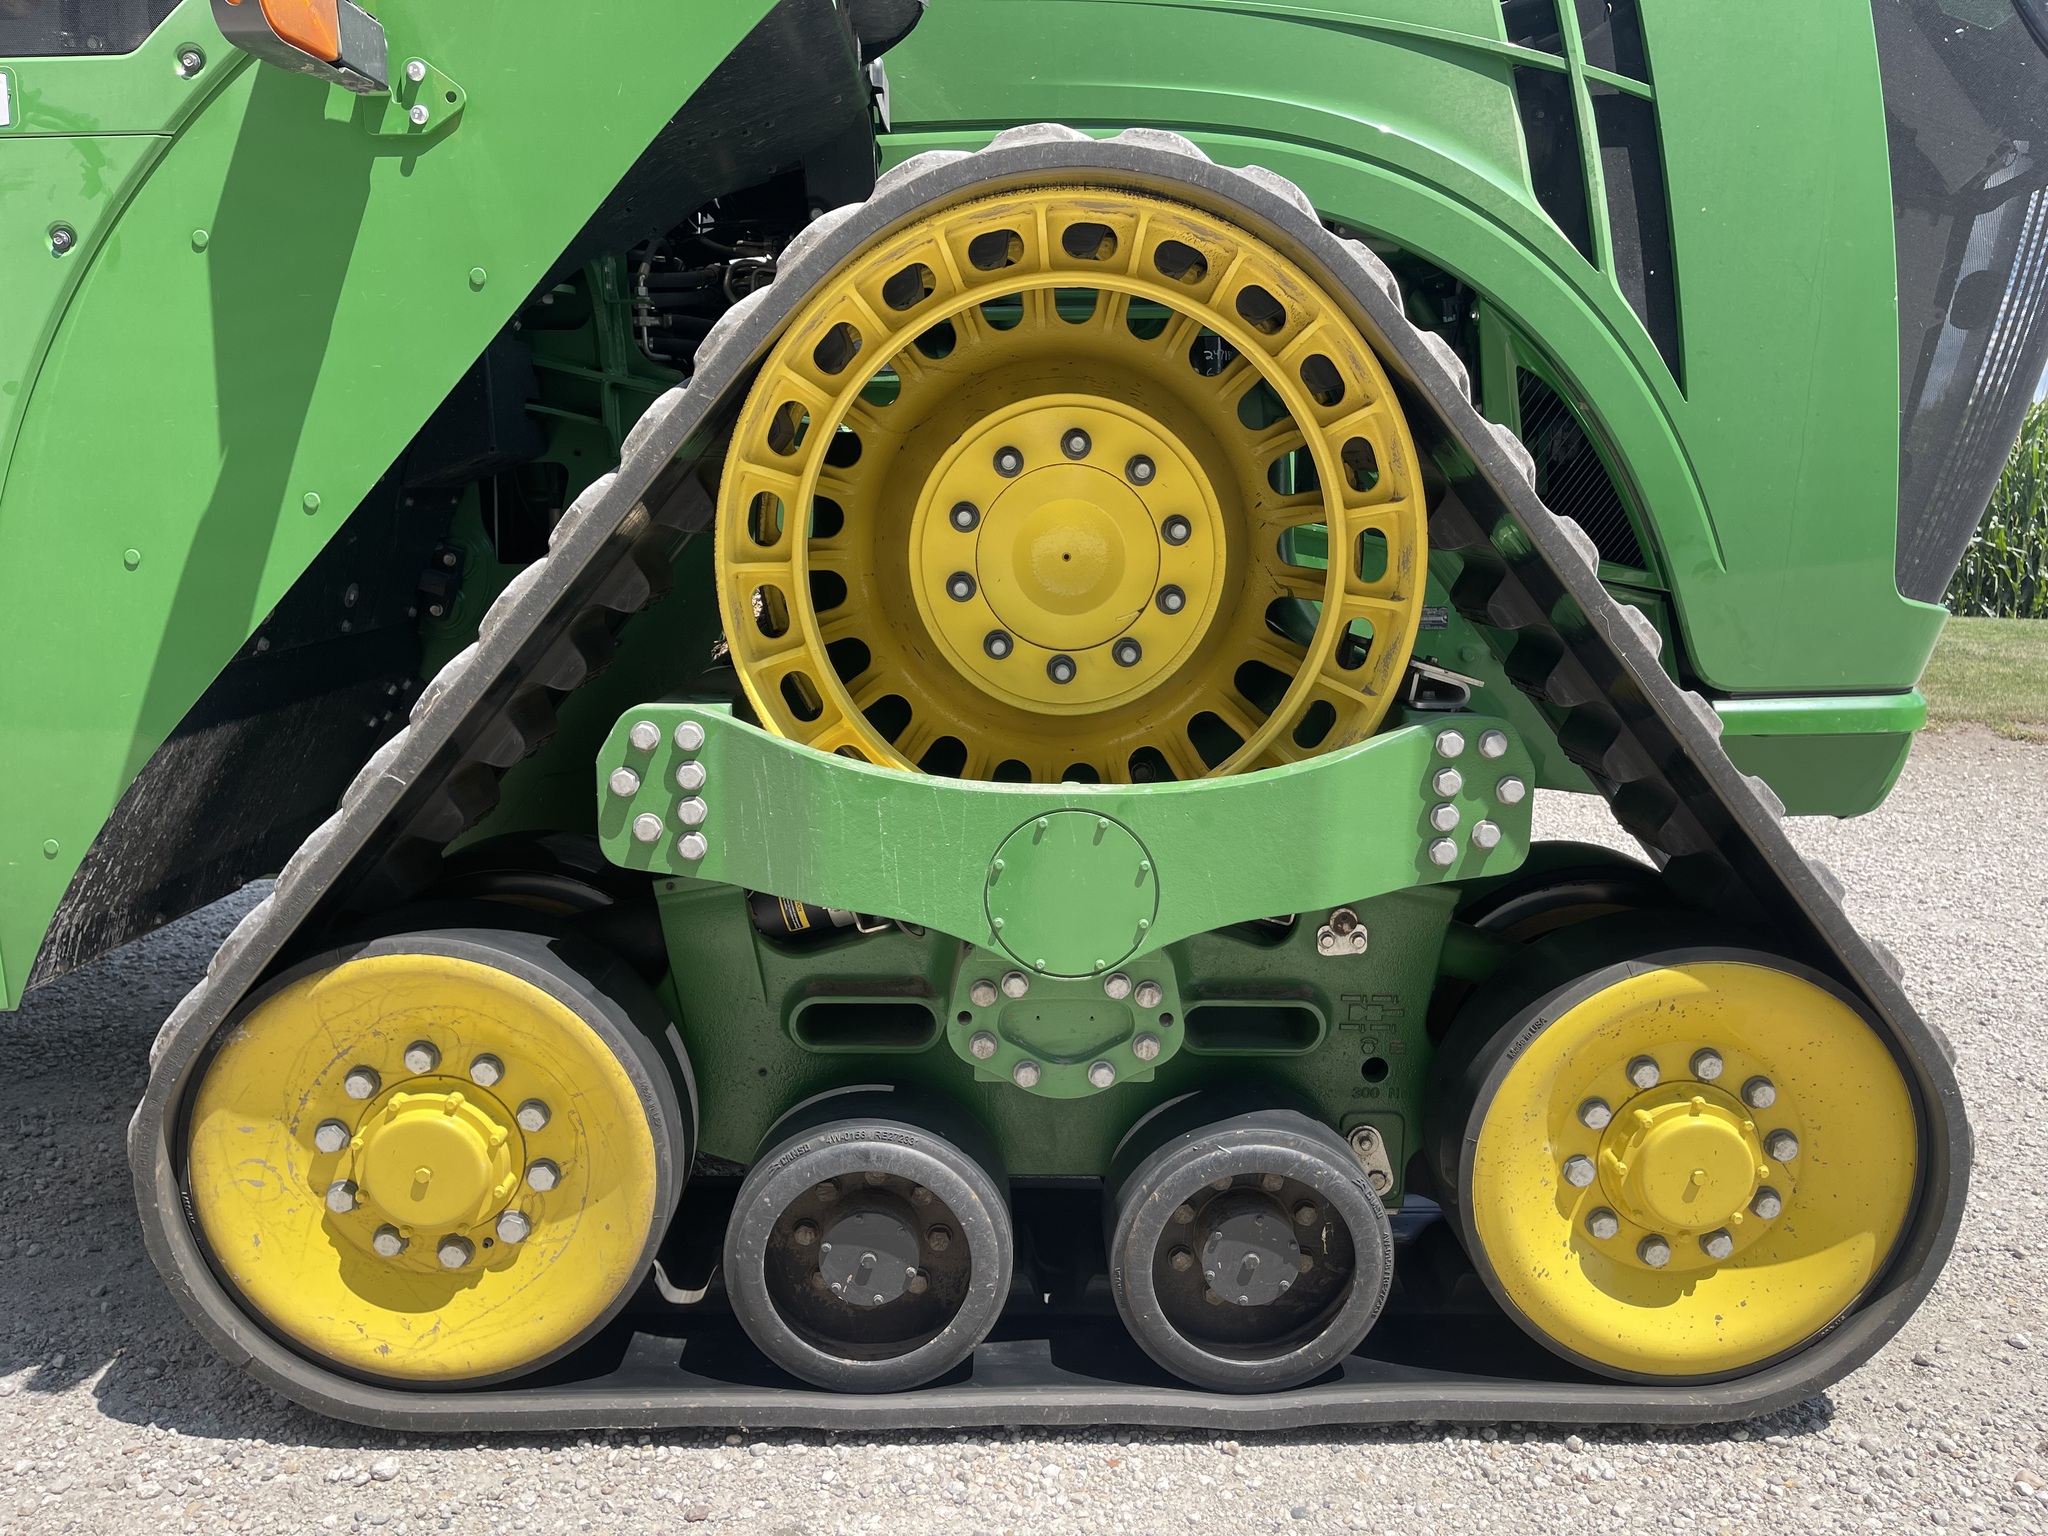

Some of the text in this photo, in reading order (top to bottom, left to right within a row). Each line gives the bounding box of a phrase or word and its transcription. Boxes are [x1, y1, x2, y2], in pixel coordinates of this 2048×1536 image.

[1506, 1038, 1527, 1060] Made
[1528, 1016, 1549, 1034] USA
[1351, 1086, 1380, 1099] 300
[779, 1143, 811, 1166] CAMSO
[1363, 1188, 1384, 1219] CAMSO
